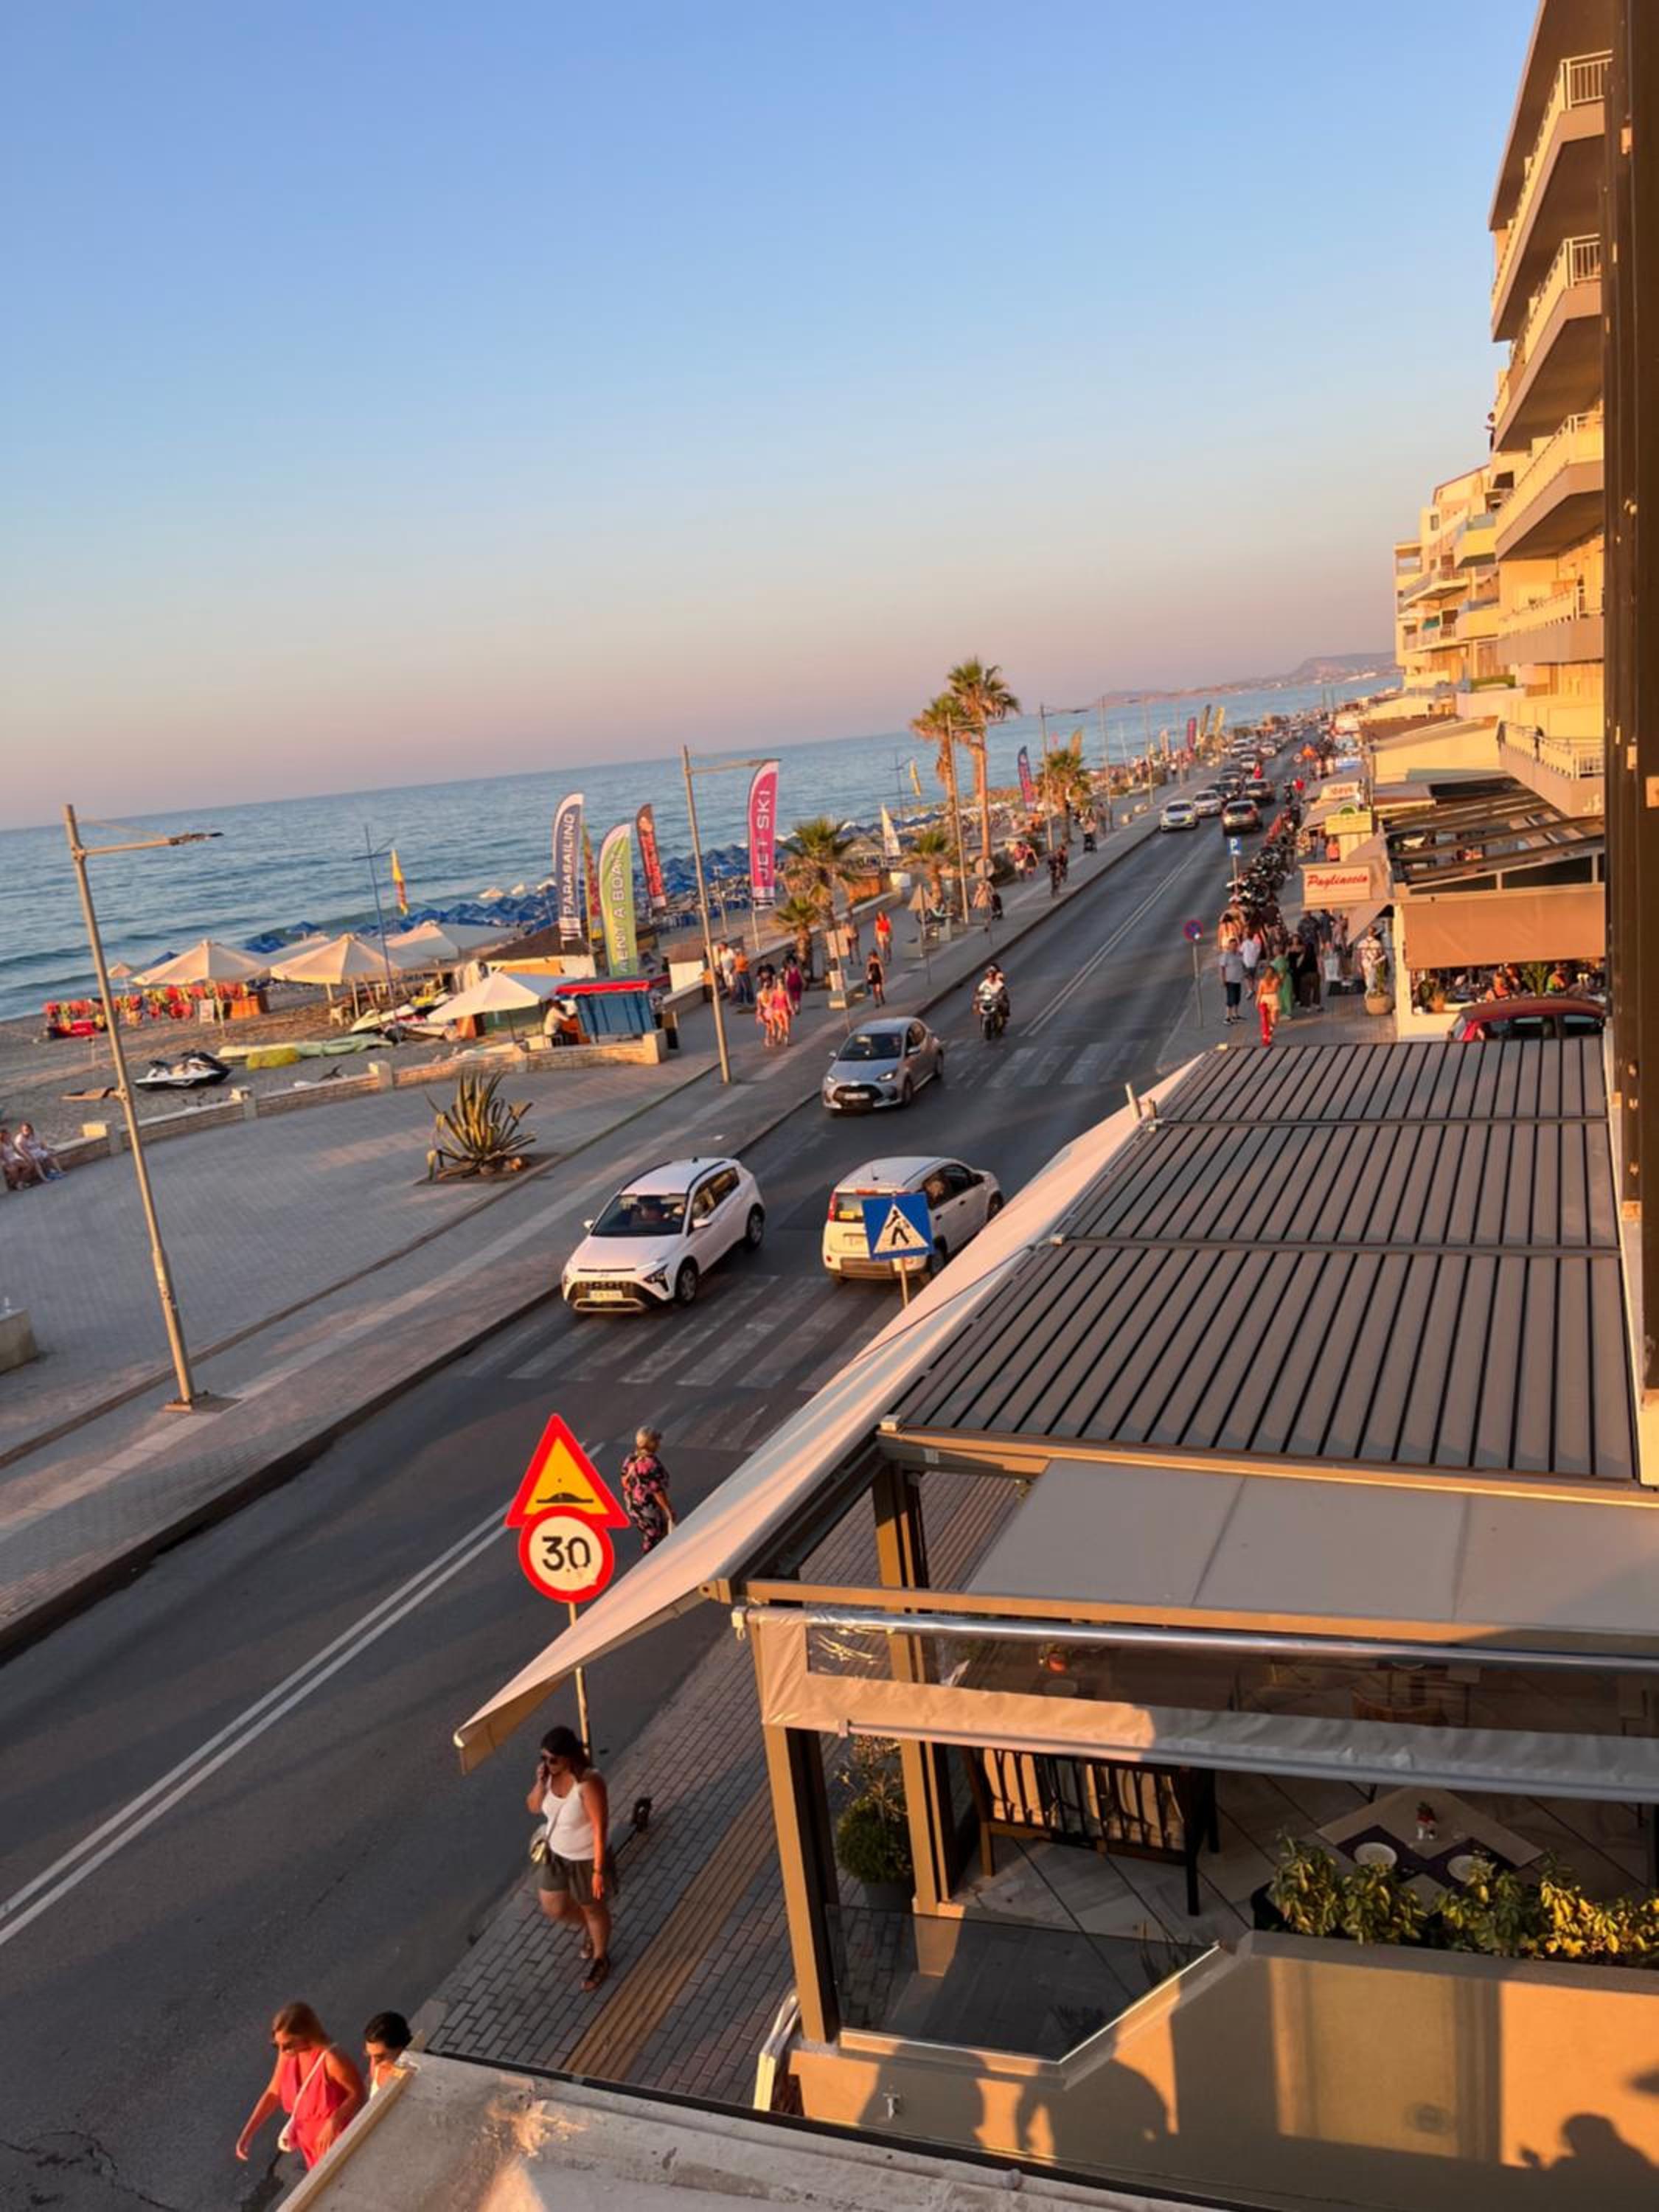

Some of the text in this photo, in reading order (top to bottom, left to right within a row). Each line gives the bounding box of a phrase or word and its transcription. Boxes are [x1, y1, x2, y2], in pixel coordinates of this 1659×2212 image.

[757, 790, 771, 880] JET SKI
[1230, 838, 1238, 849] P
[563, 813, 575, 915] PARASAILING
[613, 907, 625, 918] A
[542, 1536, 591, 1571] 30
